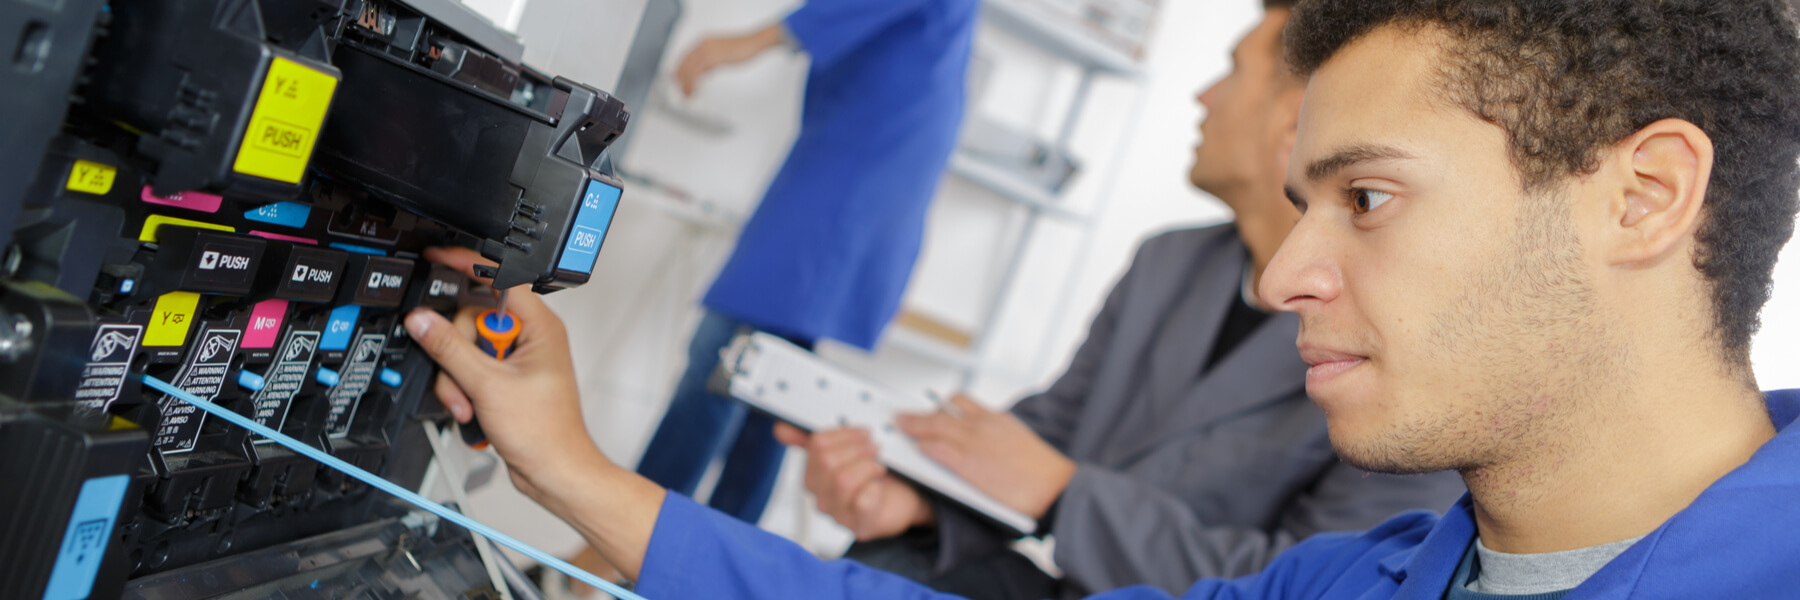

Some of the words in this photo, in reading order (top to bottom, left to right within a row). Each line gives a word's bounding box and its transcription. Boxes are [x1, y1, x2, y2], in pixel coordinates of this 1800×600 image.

[261, 125, 303, 151] PUSH
[585, 193, 594, 208] C
[574, 231, 597, 249] PUSH
[219, 255, 250, 270] PUSH
[308, 268, 333, 284] PUSH
[381, 274, 403, 289] PUSH
[162, 311, 172, 326] Y
[254, 317, 265, 330] M
[332, 320, 340, 333] C
[90, 366, 125, 376] WARNING
[198, 366, 225, 375] WARNING
[191, 376, 221, 385] ATTENTION
[172, 406, 196, 415] AVVISO
[168, 416, 189, 425] AVISO
